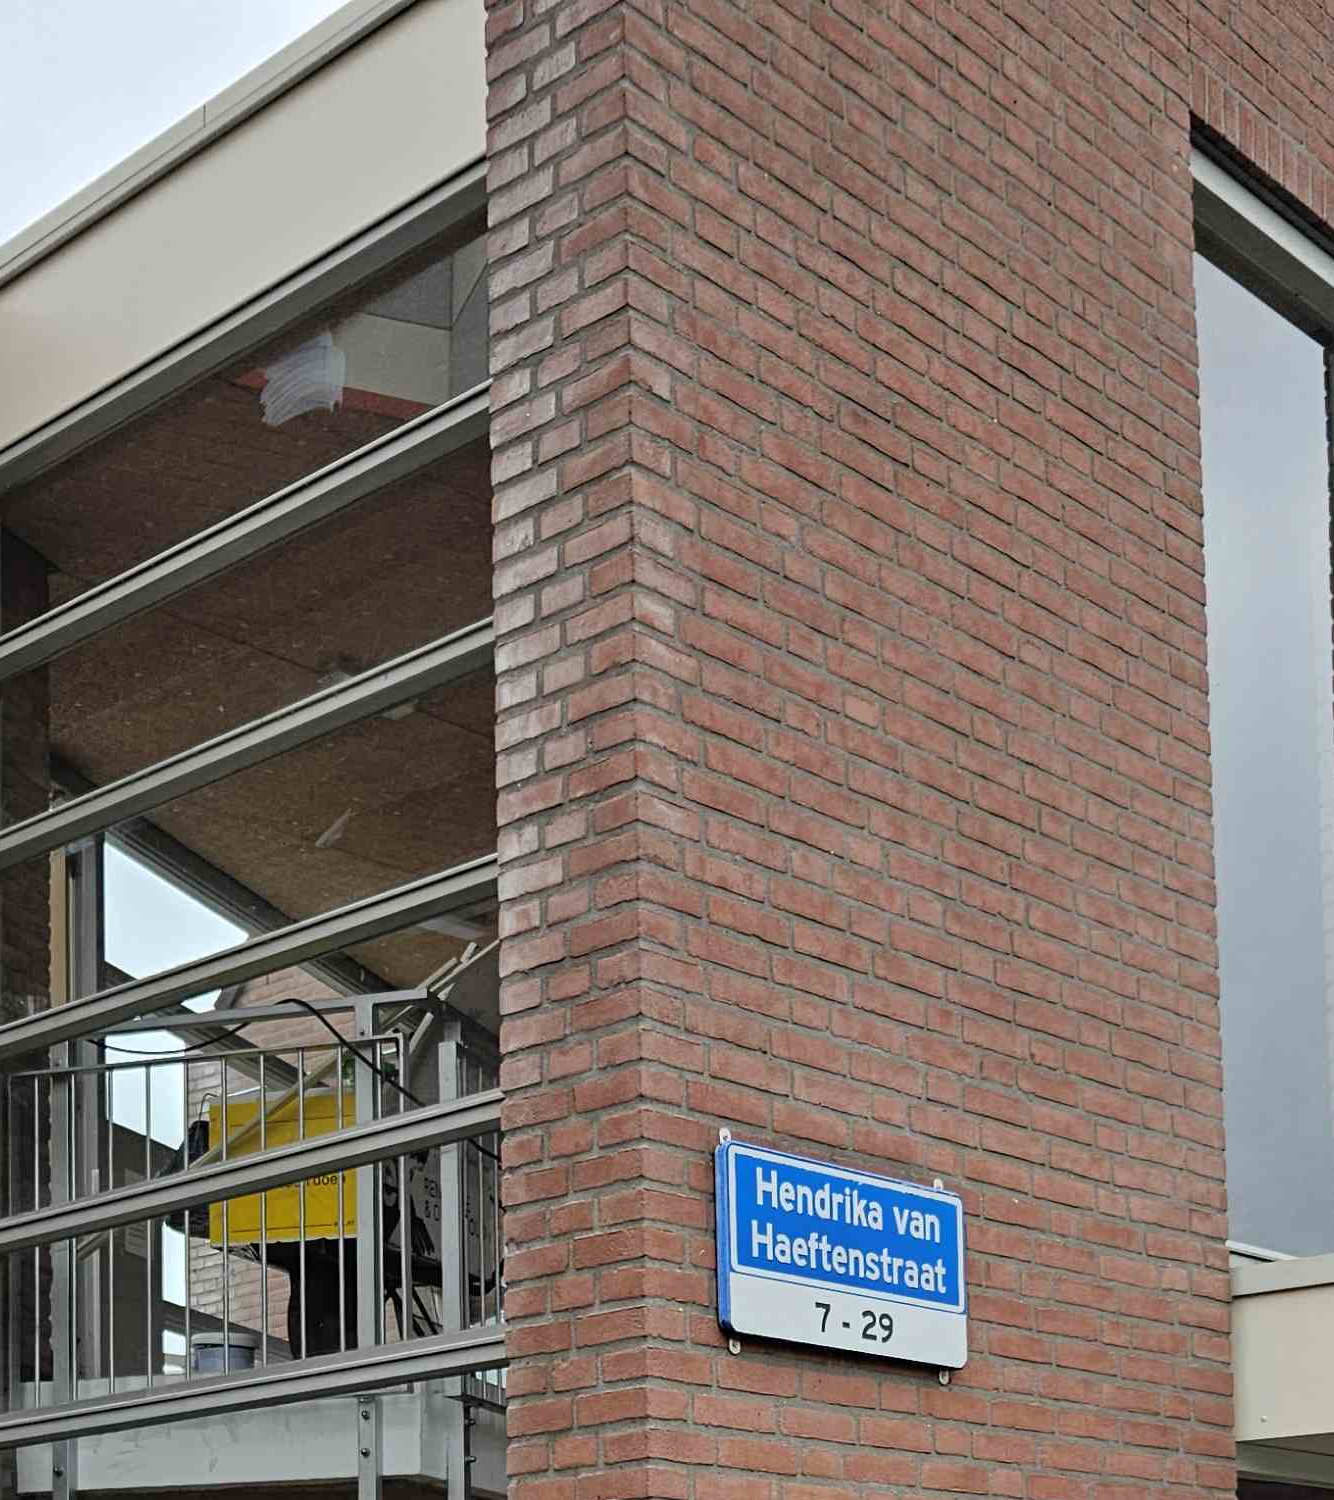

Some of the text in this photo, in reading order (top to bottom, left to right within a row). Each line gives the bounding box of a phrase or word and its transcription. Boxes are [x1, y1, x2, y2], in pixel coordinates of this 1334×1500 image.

[755, 1166, 941, 1244] Hendrika van
[750, 1219, 947, 1295] Haeftenstraat
[815, 1301, 831, 1333] 7
[861, 1310, 894, 1344] 29
